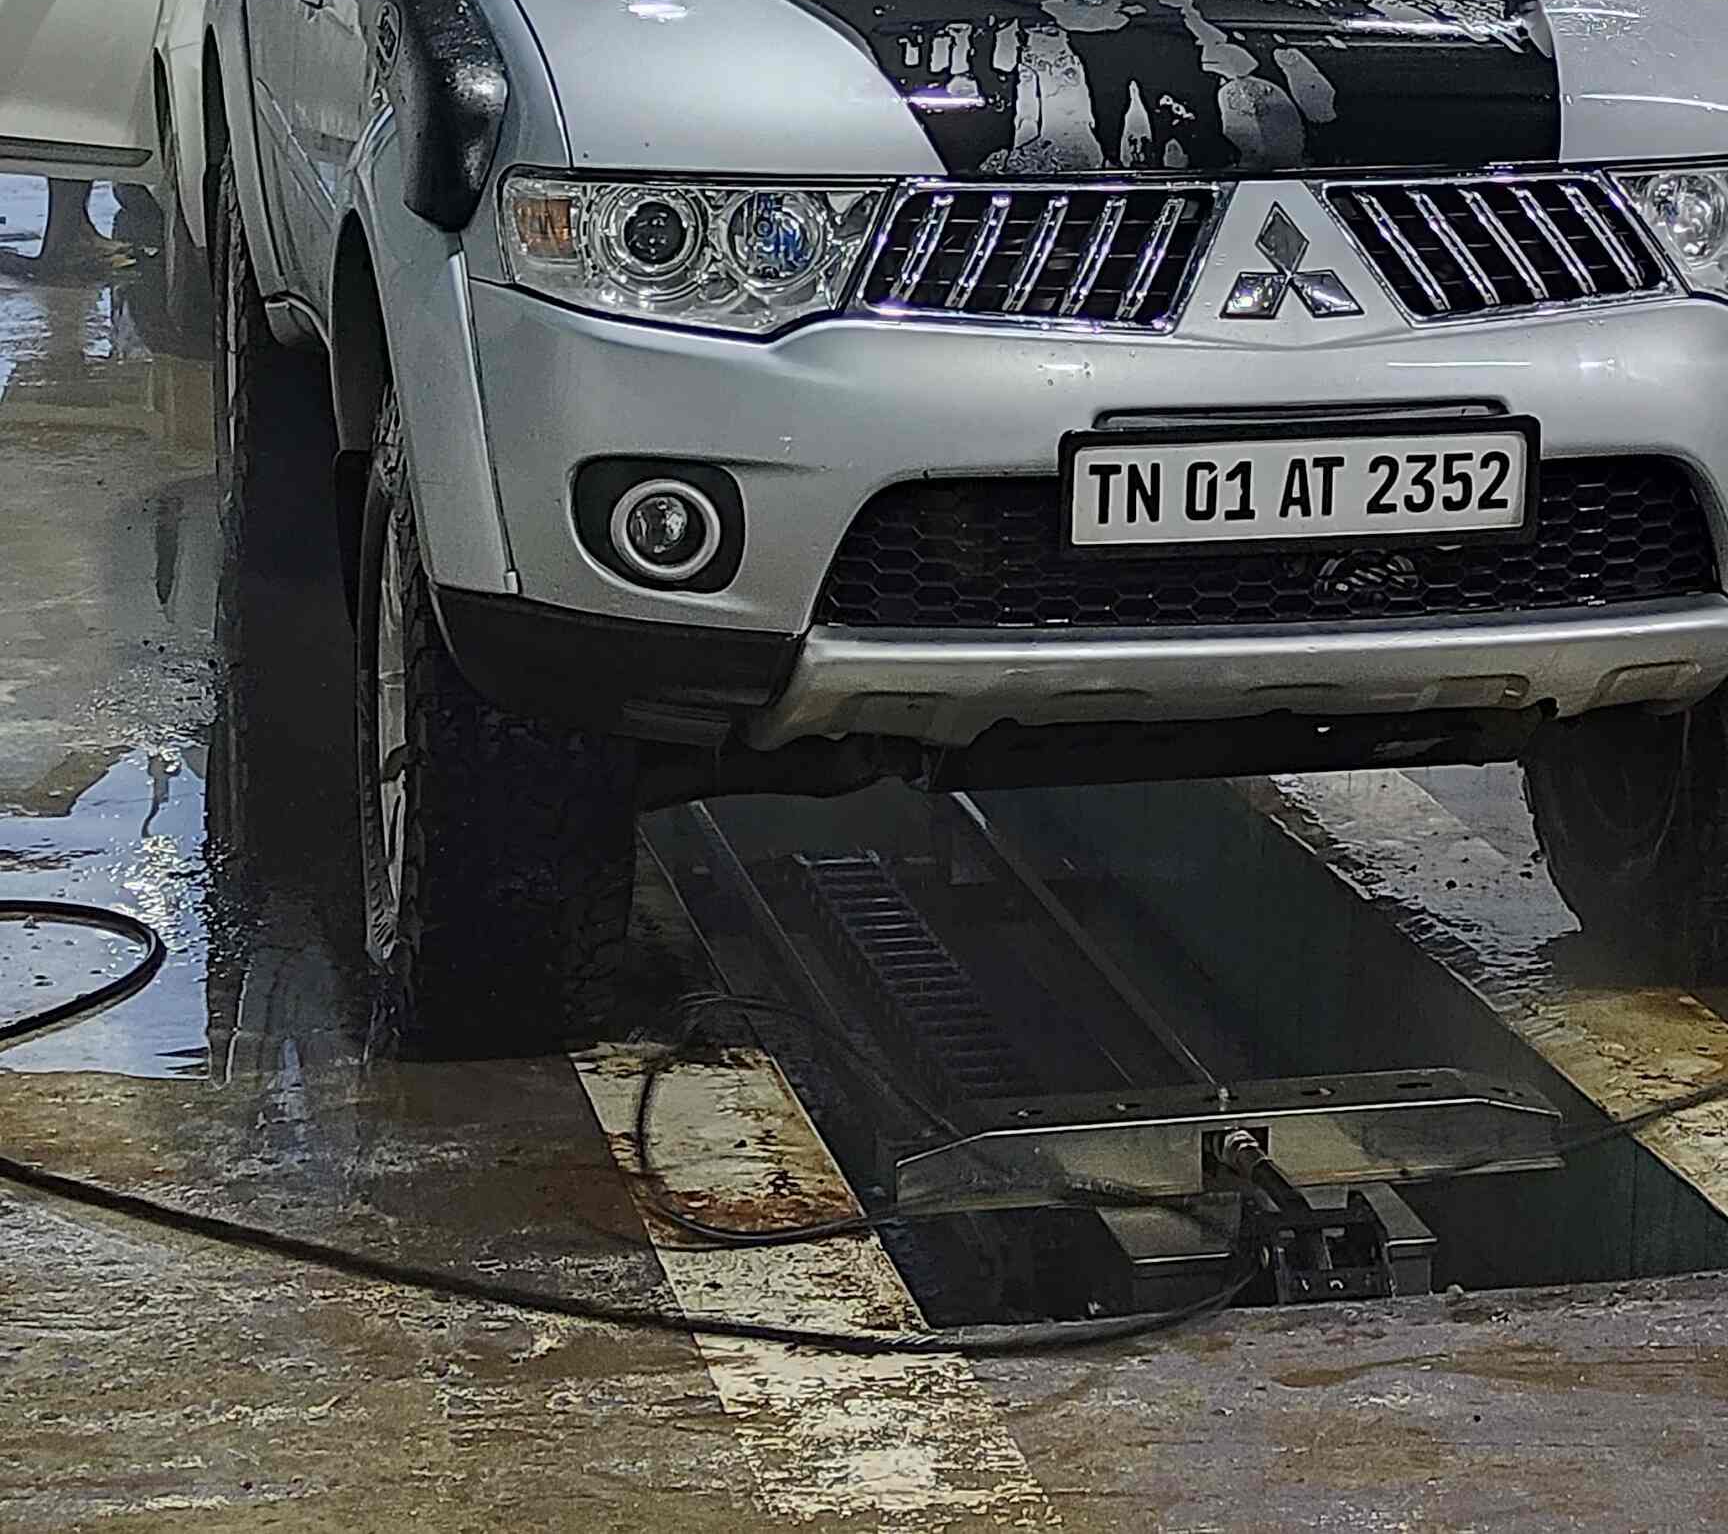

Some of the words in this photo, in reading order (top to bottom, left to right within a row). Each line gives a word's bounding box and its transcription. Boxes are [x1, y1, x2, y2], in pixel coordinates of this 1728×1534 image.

[1089, 462, 1161, 524] TN
[1185, 460, 1256, 521] 01
[1279, 456, 1345, 517] AT
[1366, 451, 1510, 514] 2352
